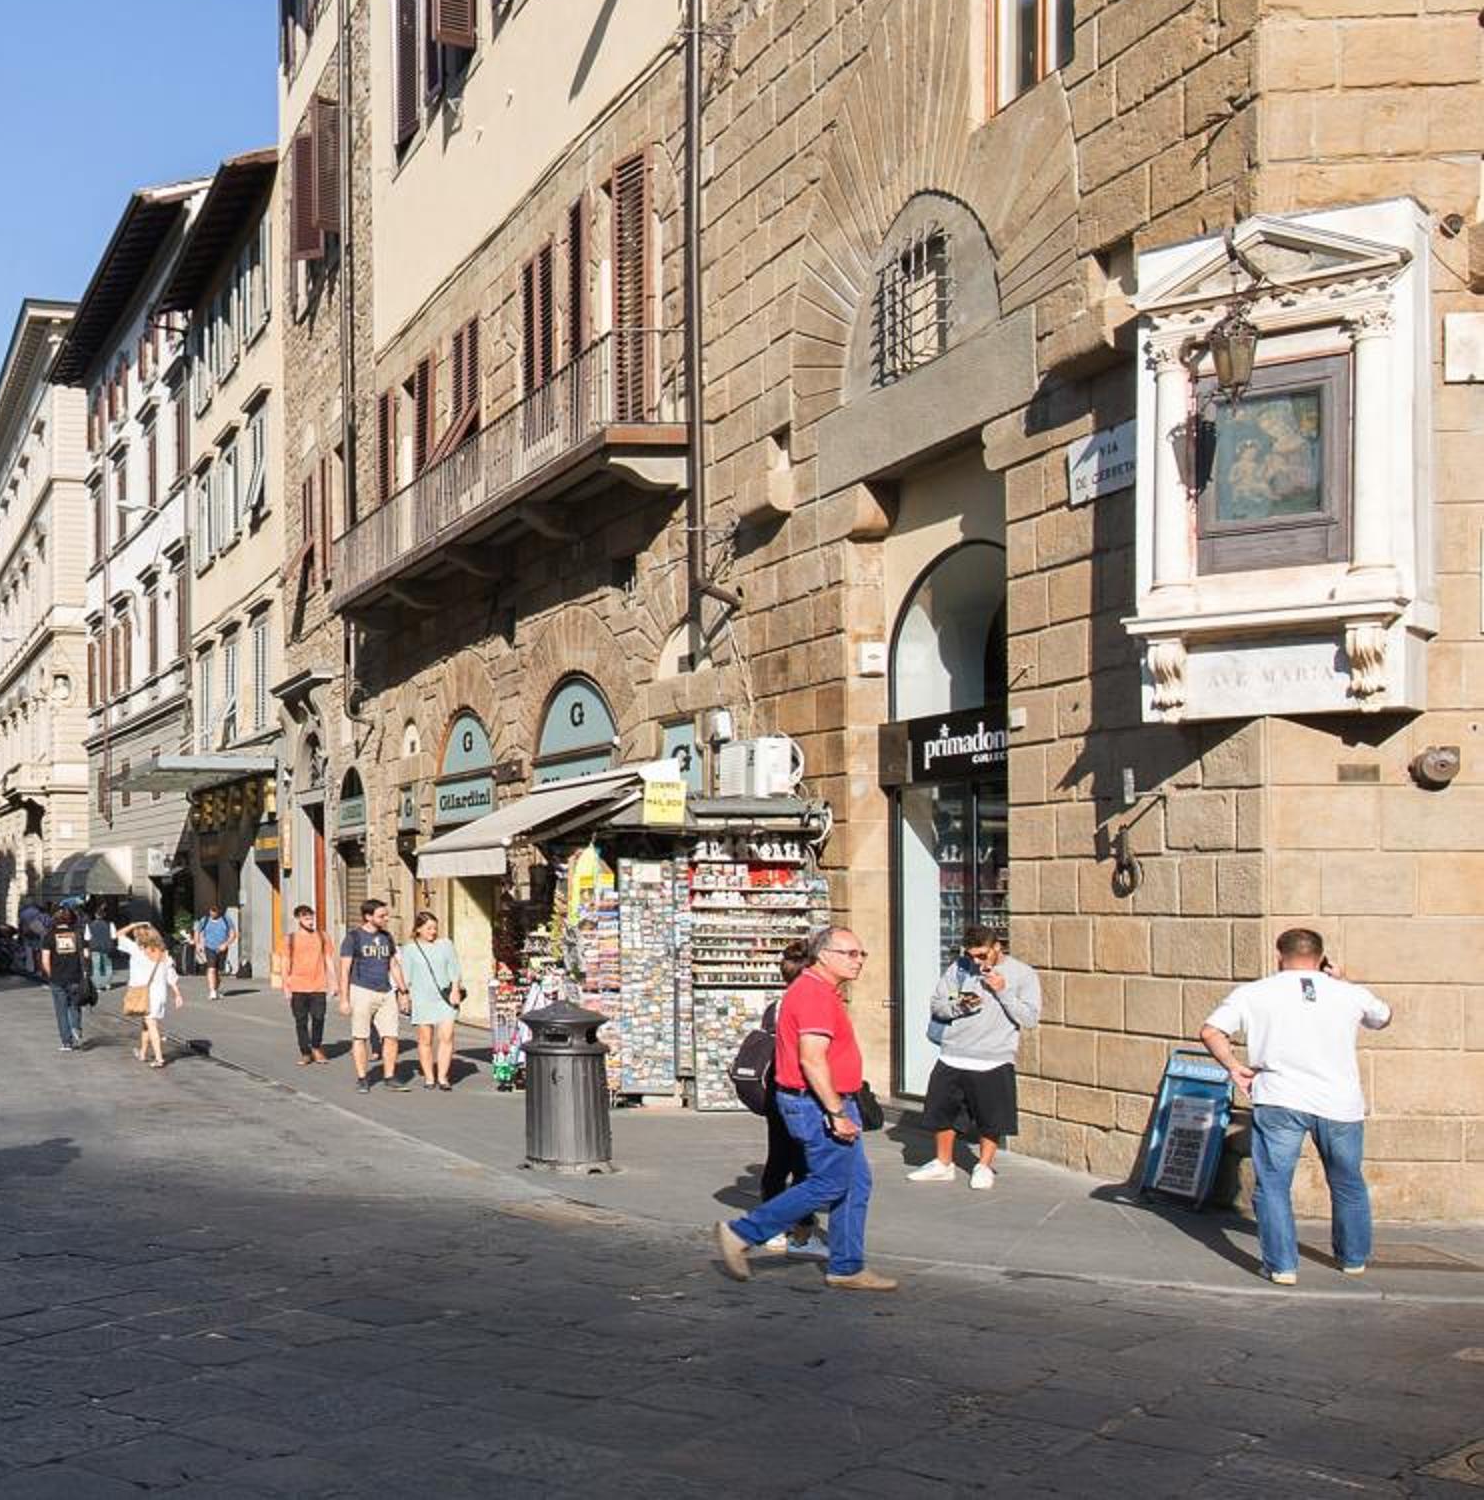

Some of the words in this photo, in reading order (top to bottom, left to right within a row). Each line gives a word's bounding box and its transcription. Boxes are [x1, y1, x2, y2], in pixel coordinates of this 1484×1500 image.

[1099, 439, 1118, 458] VIA
[569, 702, 584, 727] G
[462, 731, 473, 752] G
[439, 787, 491, 812] Gilardini
